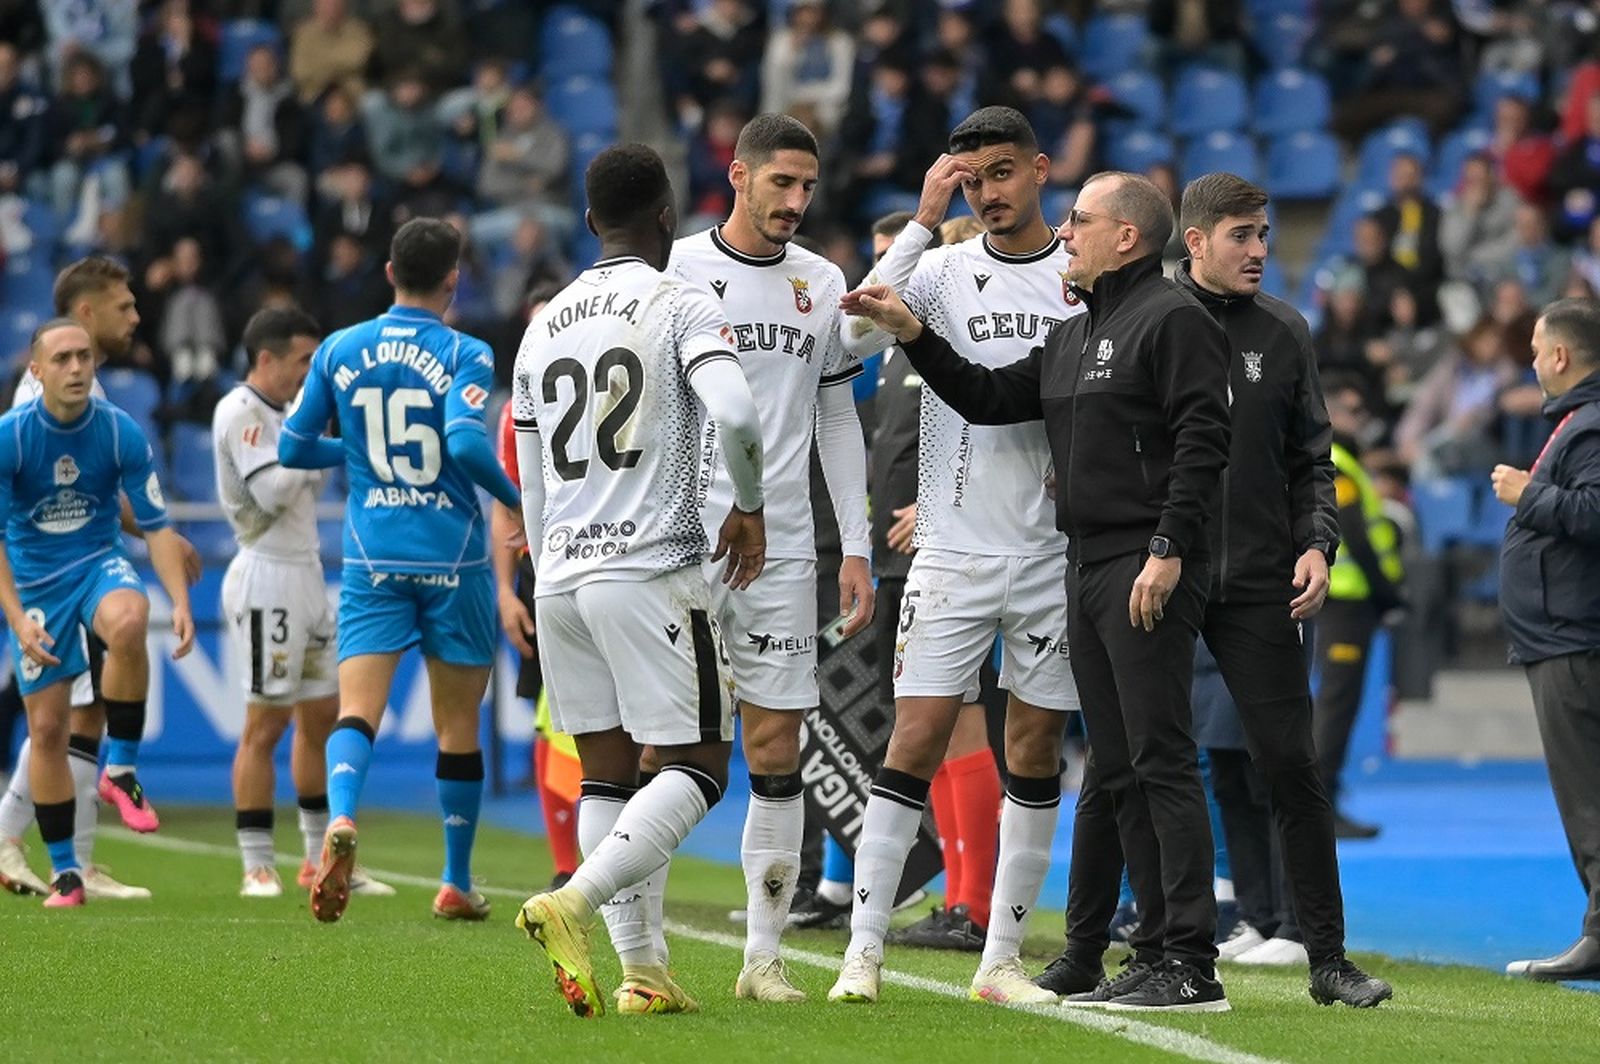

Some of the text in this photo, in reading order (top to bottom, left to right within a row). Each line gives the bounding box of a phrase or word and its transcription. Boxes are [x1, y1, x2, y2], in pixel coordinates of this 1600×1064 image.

[733, 323, 815, 364] EUTA
[967, 312, 1064, 342] CEUT
[333, 341, 453, 396] M. LOUREIRO
[542, 347, 644, 482] 22
[351, 387, 442, 486] 15
[958, 422, 970, 464] ALMIN
[565, 541, 629, 560] MOTOR
[271, 608, 290, 643] 3
[771, 634, 817, 651] HÉLIT
[806, 709, 873, 798] RMOTION
[801, 749, 866, 849] LIGA
